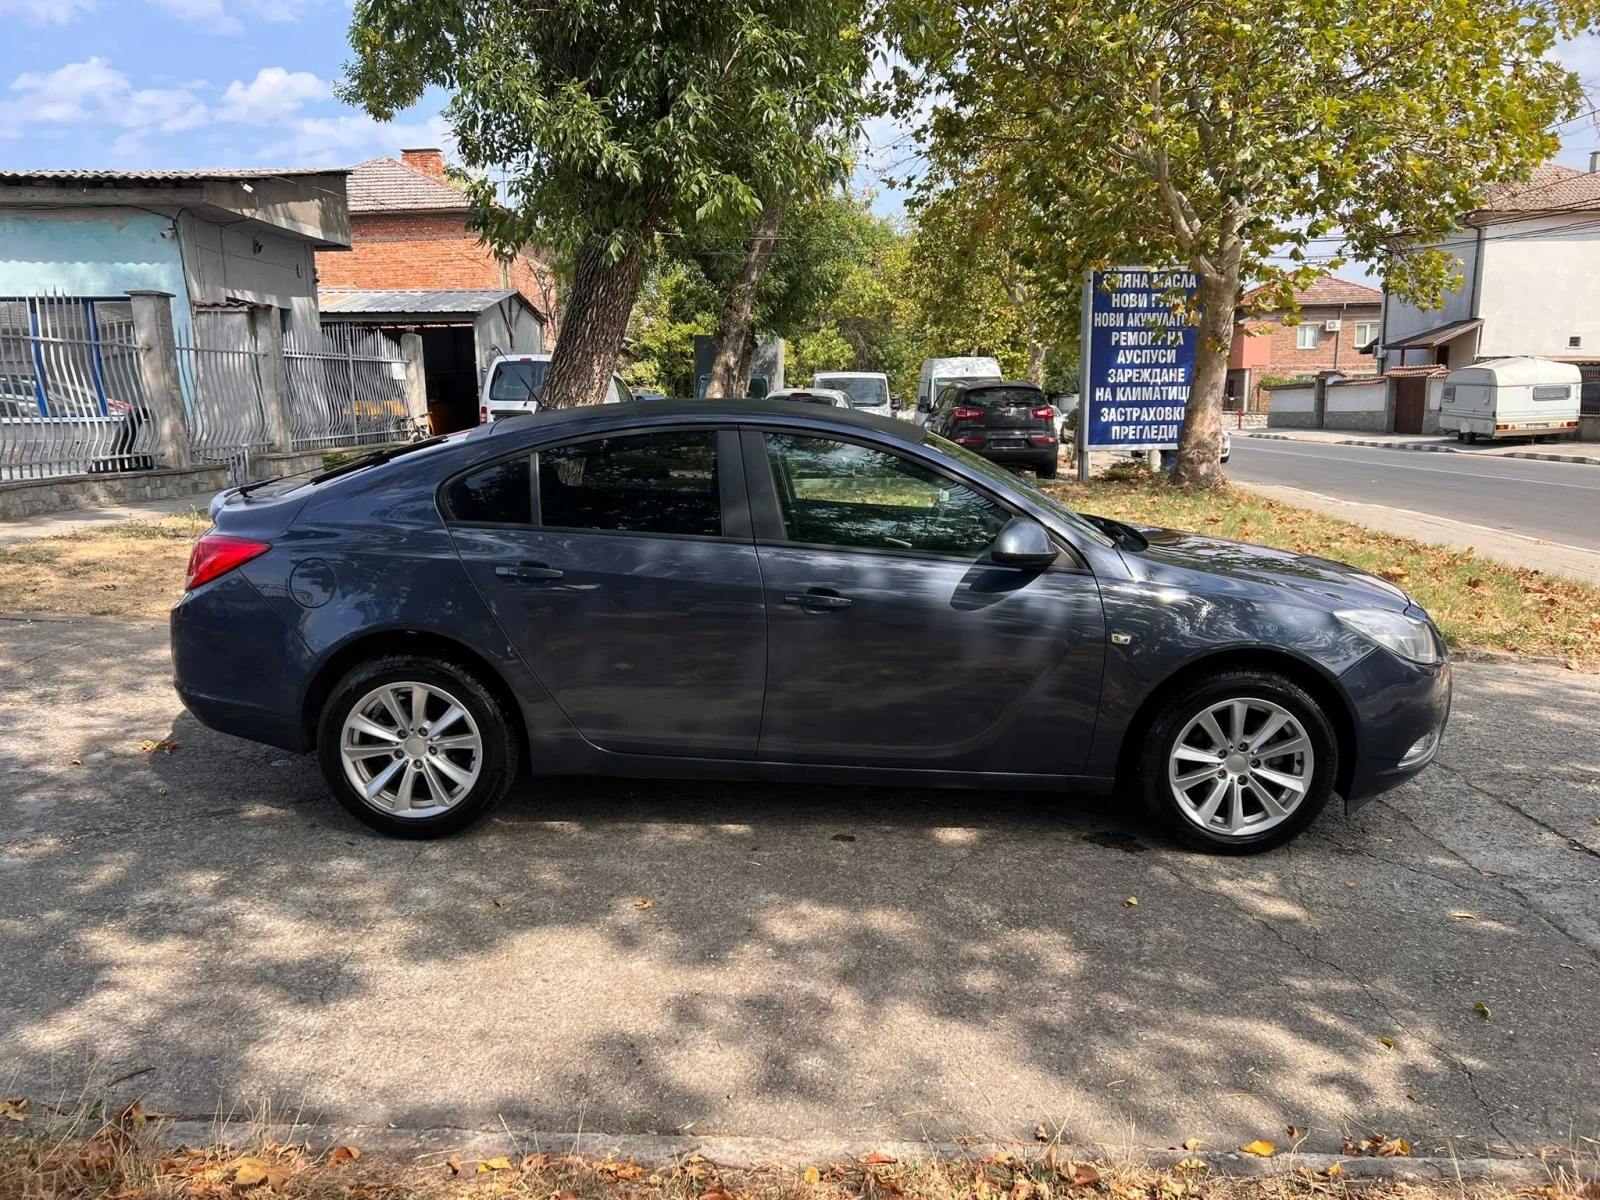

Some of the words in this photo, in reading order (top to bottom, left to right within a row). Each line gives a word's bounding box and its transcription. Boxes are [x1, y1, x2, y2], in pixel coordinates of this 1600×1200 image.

[1111, 293, 1148, 308] НОВИ
[1094, 312, 1124, 327] НОВИ
[1117, 349, 1176, 364] АУСПУСИ
[1107, 368, 1186, 386] ЗАРЕЖДАНЕ
[1095, 387, 1113, 402] НА
[1111, 425, 1178, 442] ПРЕГЛЕДИ
